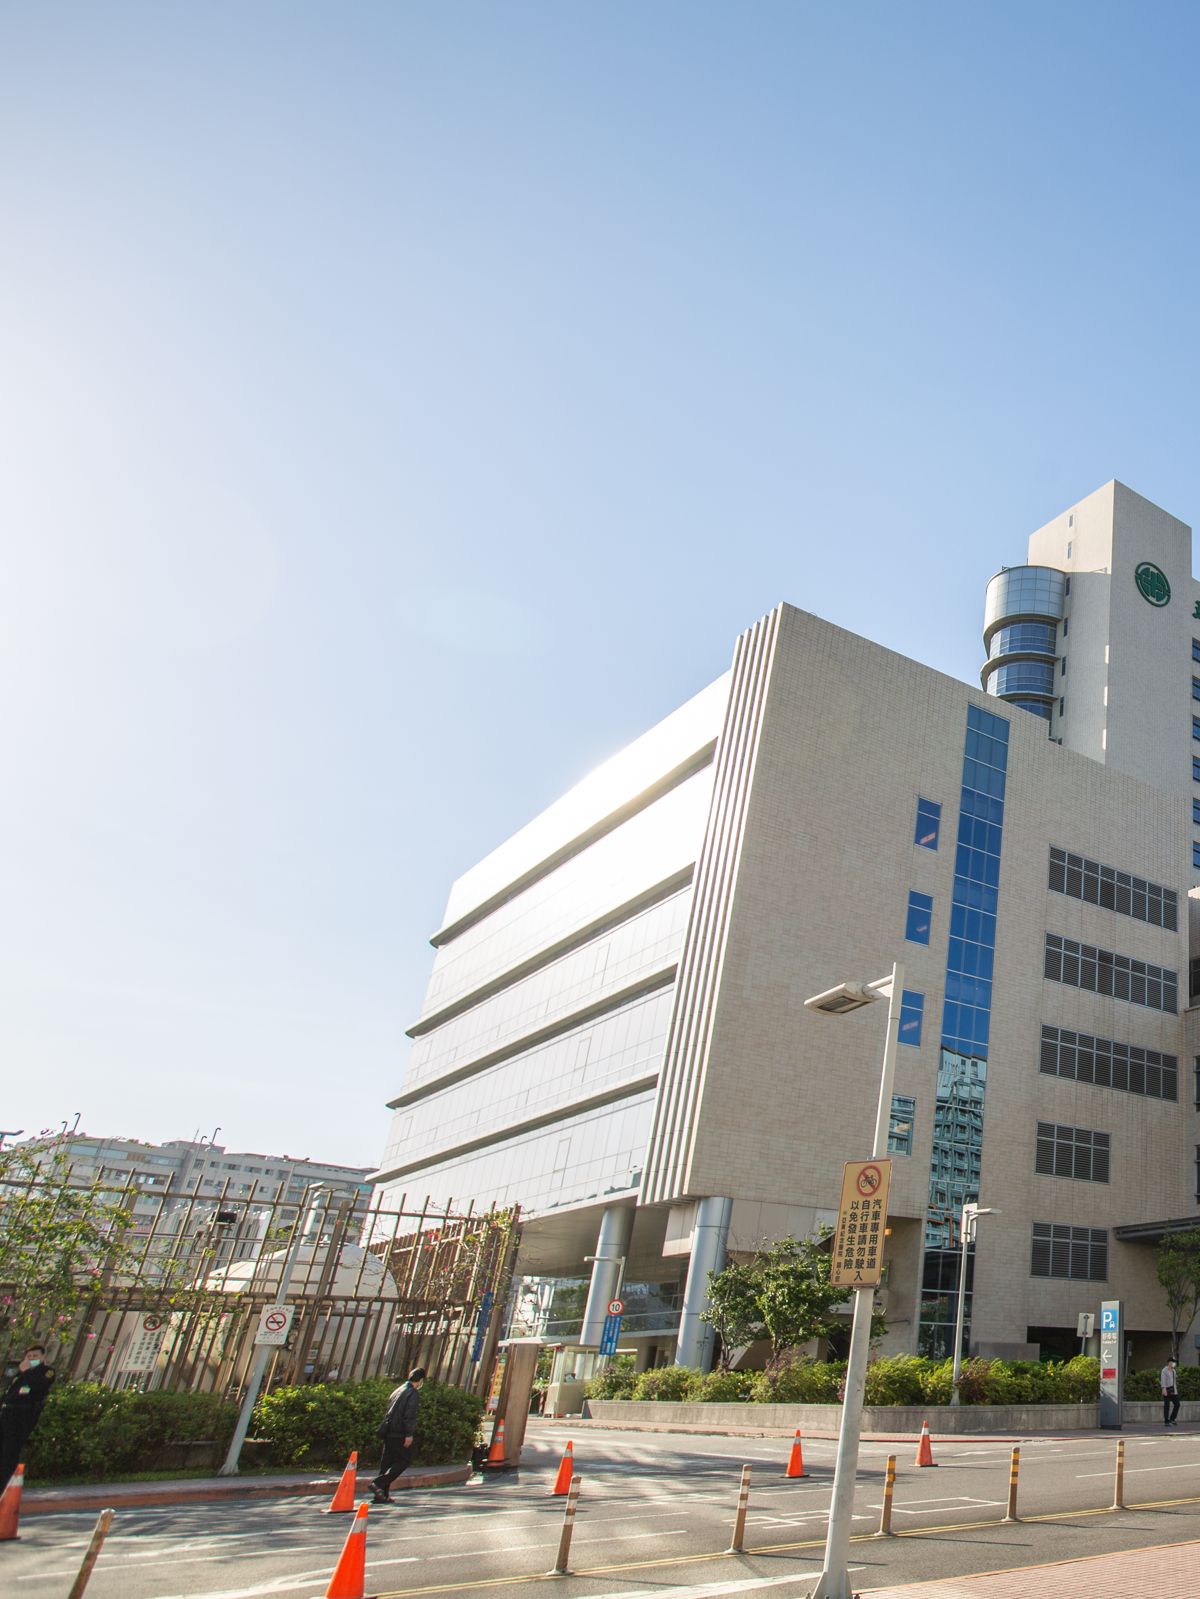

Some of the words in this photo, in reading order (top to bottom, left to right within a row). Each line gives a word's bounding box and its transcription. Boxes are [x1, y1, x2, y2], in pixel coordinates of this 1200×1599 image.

[844, 1200, 859, 1270] 以免發生危險
[853, 1200, 871, 1282] 自行車請勿駛入
[866, 1199, 882, 1269] 汽車專用車道
[612, 1303, 621, 1311] 10
[1102, 1311, 1112, 1329] P
